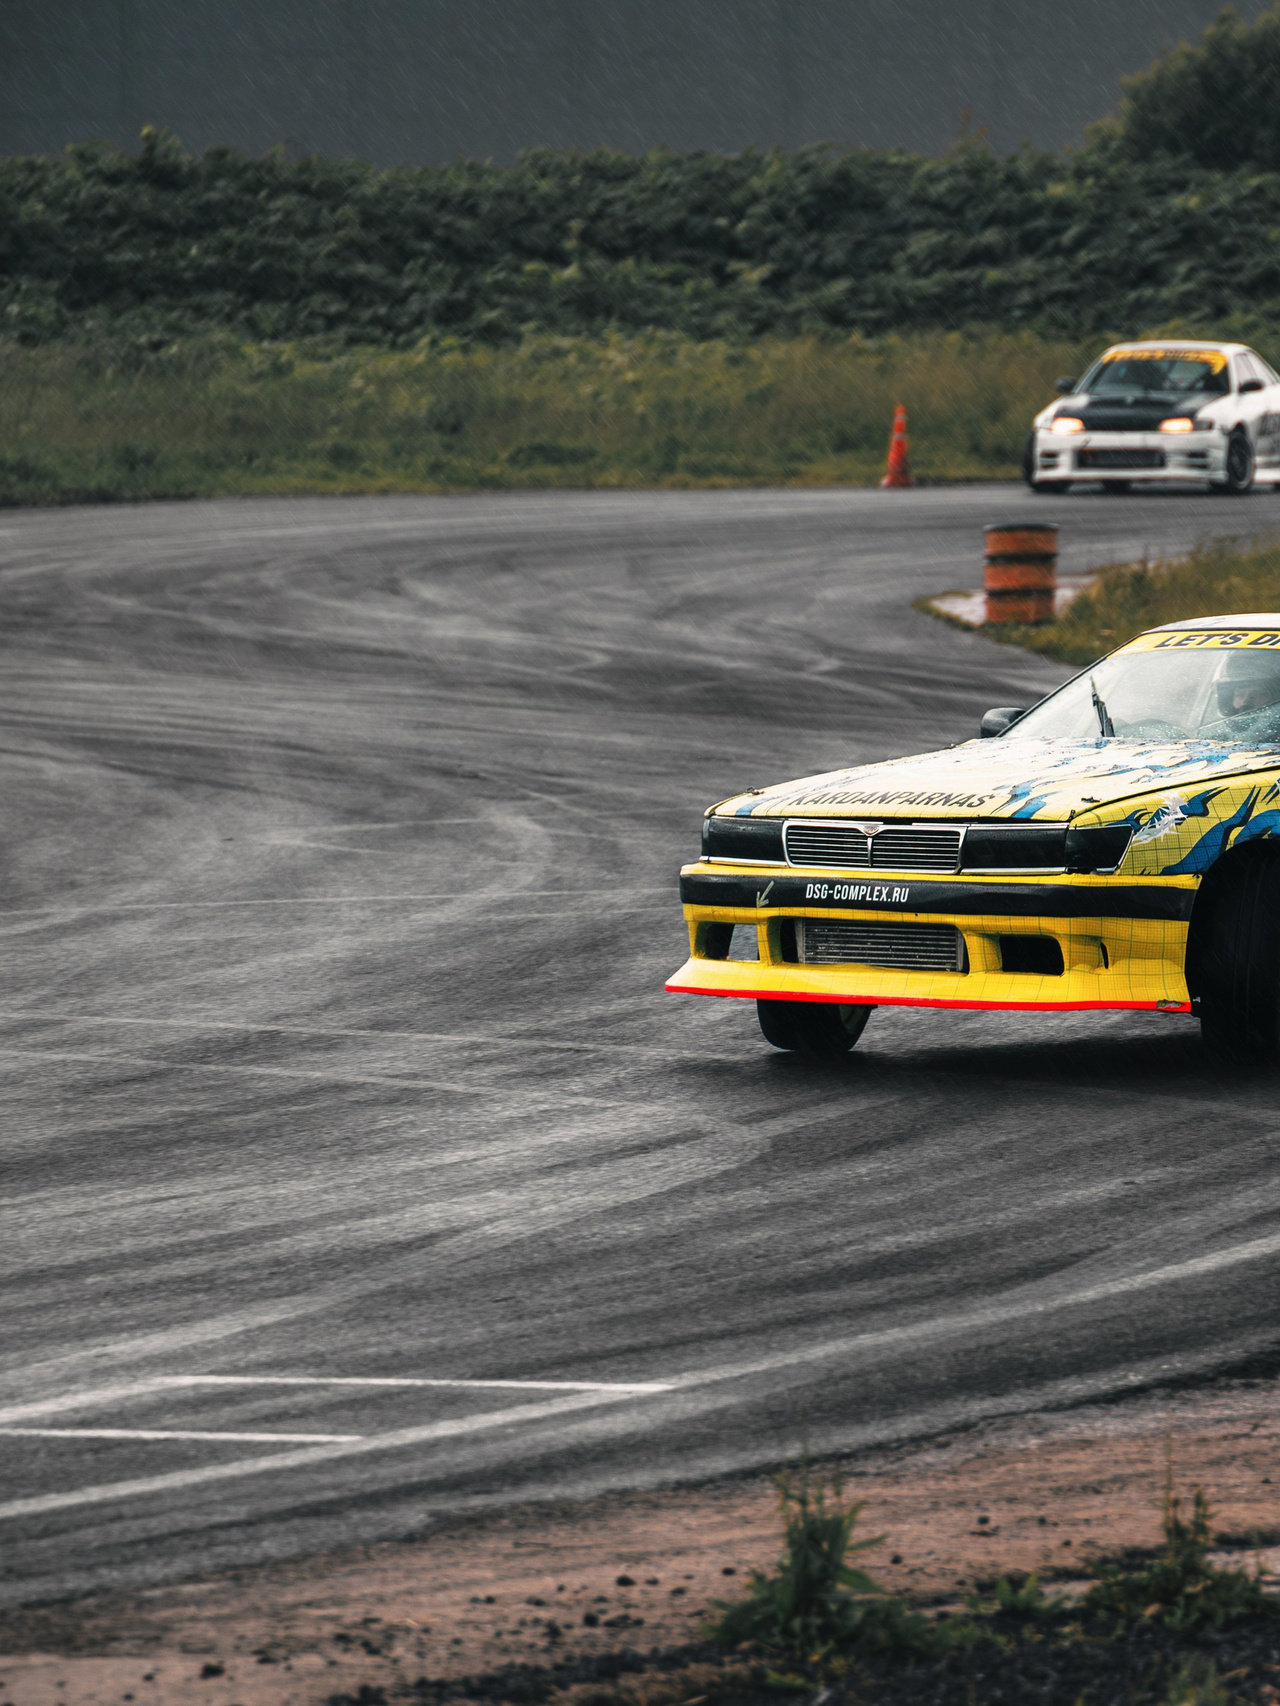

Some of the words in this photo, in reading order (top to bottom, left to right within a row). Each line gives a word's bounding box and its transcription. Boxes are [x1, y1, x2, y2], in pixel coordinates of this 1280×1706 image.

[1154, 632, 1250, 649] LET'S
[787, 790, 994, 809] KARDANPARNAS
[805, 883, 909, 903] DSG-COMPLEX.RU
